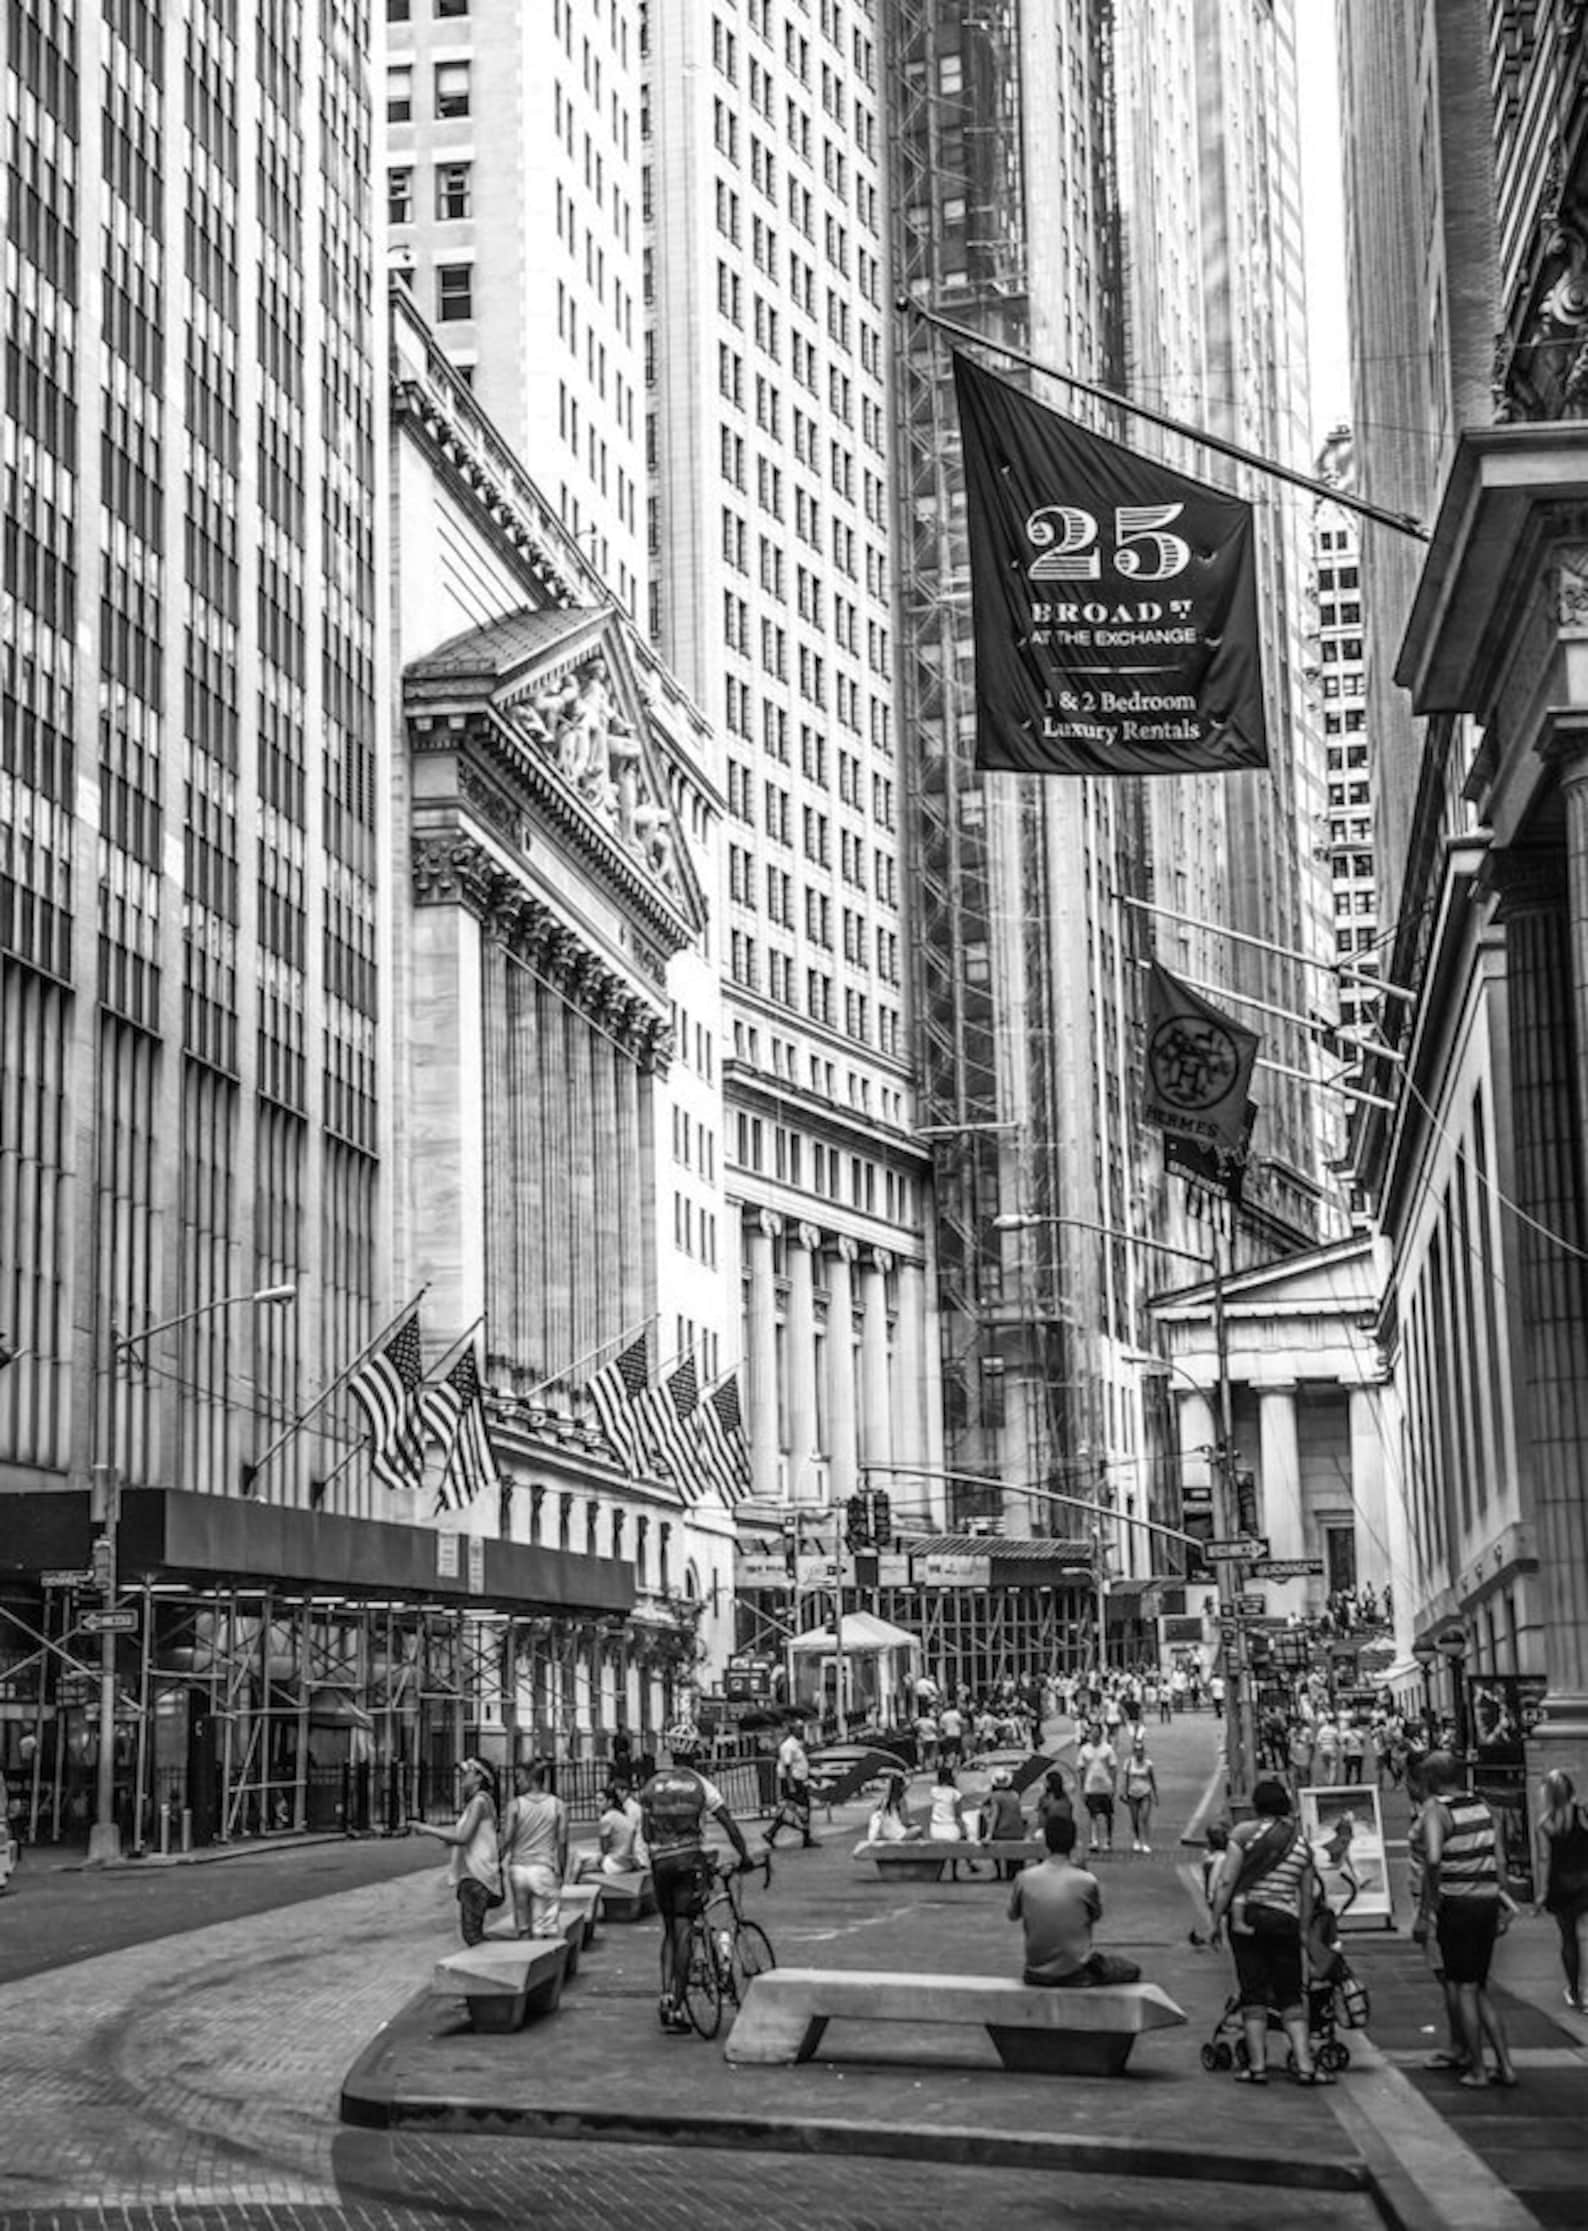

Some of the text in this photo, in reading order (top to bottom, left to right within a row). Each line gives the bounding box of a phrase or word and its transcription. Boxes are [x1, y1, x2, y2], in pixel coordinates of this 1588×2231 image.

[1026, 502, 1191, 581] 25
[1031, 602, 1162, 624] BROAD
[1031, 627, 1197, 647] AT THE EXCHANGE
[1059, 690, 1079, 712] &
[1081, 691, 1097, 712] 2
[1100, 690, 1197, 712] Bedroom
[1042, 716, 1201, 746] Luxury Rentals
